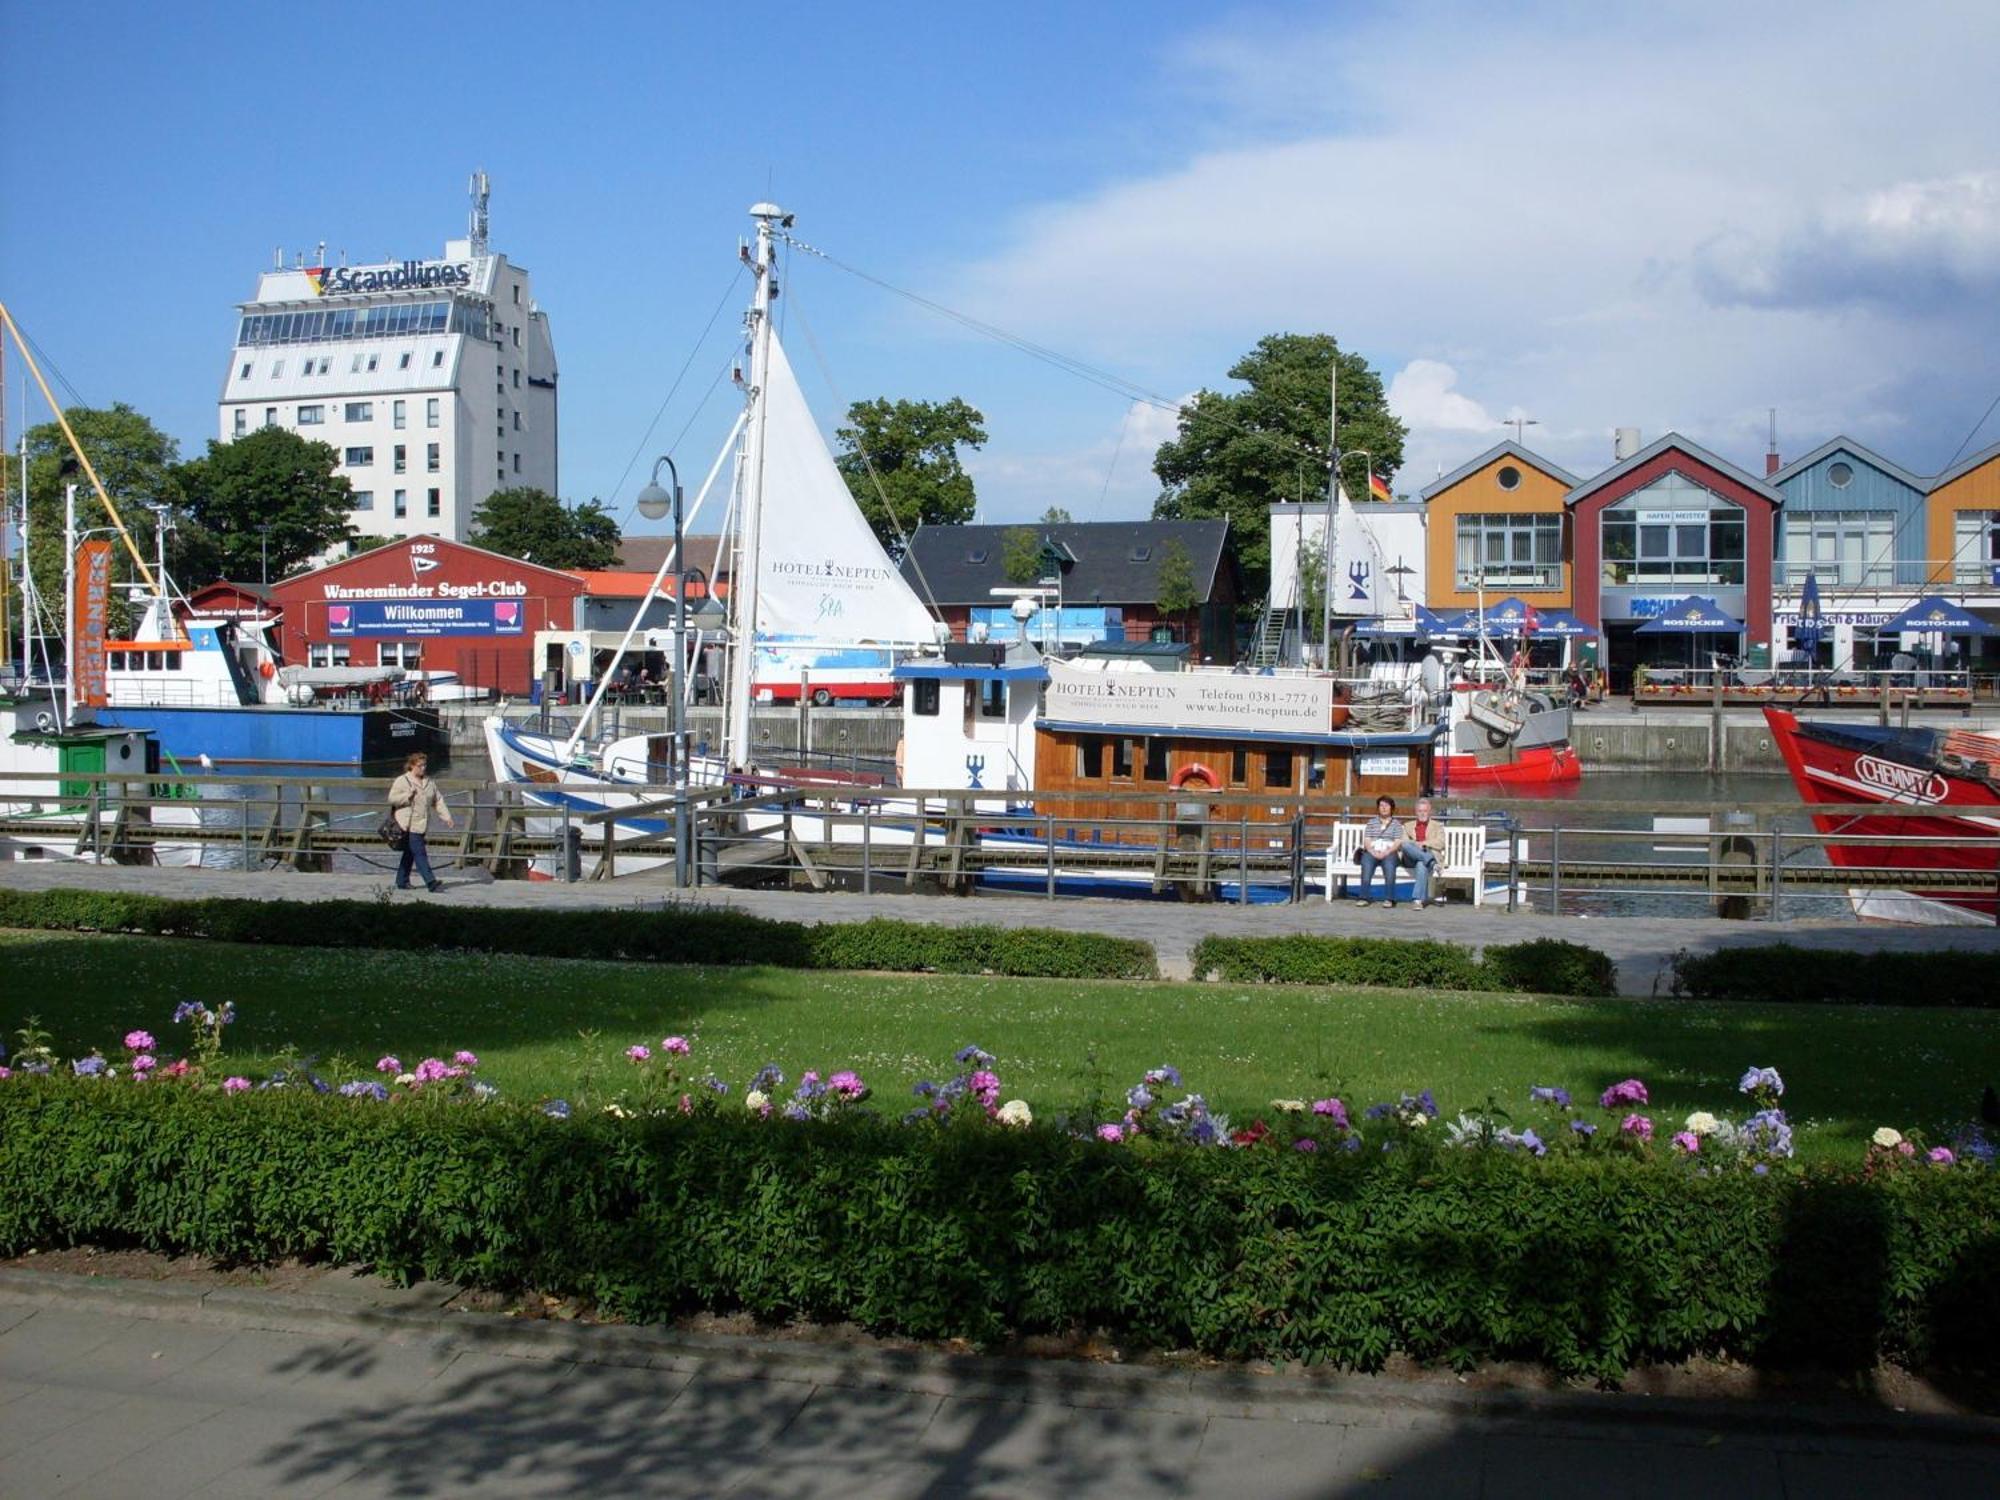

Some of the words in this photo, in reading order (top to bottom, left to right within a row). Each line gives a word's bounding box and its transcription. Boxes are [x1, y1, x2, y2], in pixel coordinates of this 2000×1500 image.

[335, 261, 470, 291] Scandlines
[1646, 511, 1670, 520] HAFEN
[1675, 510, 1706, 520] MEISTER
[410, 545, 435, 554] 1925
[772, 561, 825, 576] HOTEL
[835, 566, 891, 580] NEPTUN
[324, 584, 435, 599] Warnemünder
[438, 581, 527, 599] Segel-Club
[384, 605, 464, 620] Willkommen
[1845, 614, 1855, 625] &
[1663, 619, 1724, 627] ROSTOCKER
[1056, 682, 1106, 696] HOTEL
[1117, 685, 1177, 699] NEPTUN
[1199, 688, 1244, 701] Telefon
[1248, 690, 1308, 703] 0381-777
[1309, 694, 1319, 704] 0
[1185, 702, 1319, 719] www.hotel-neptun.de
[1861, 758, 1938, 799] CHEMNITZ
